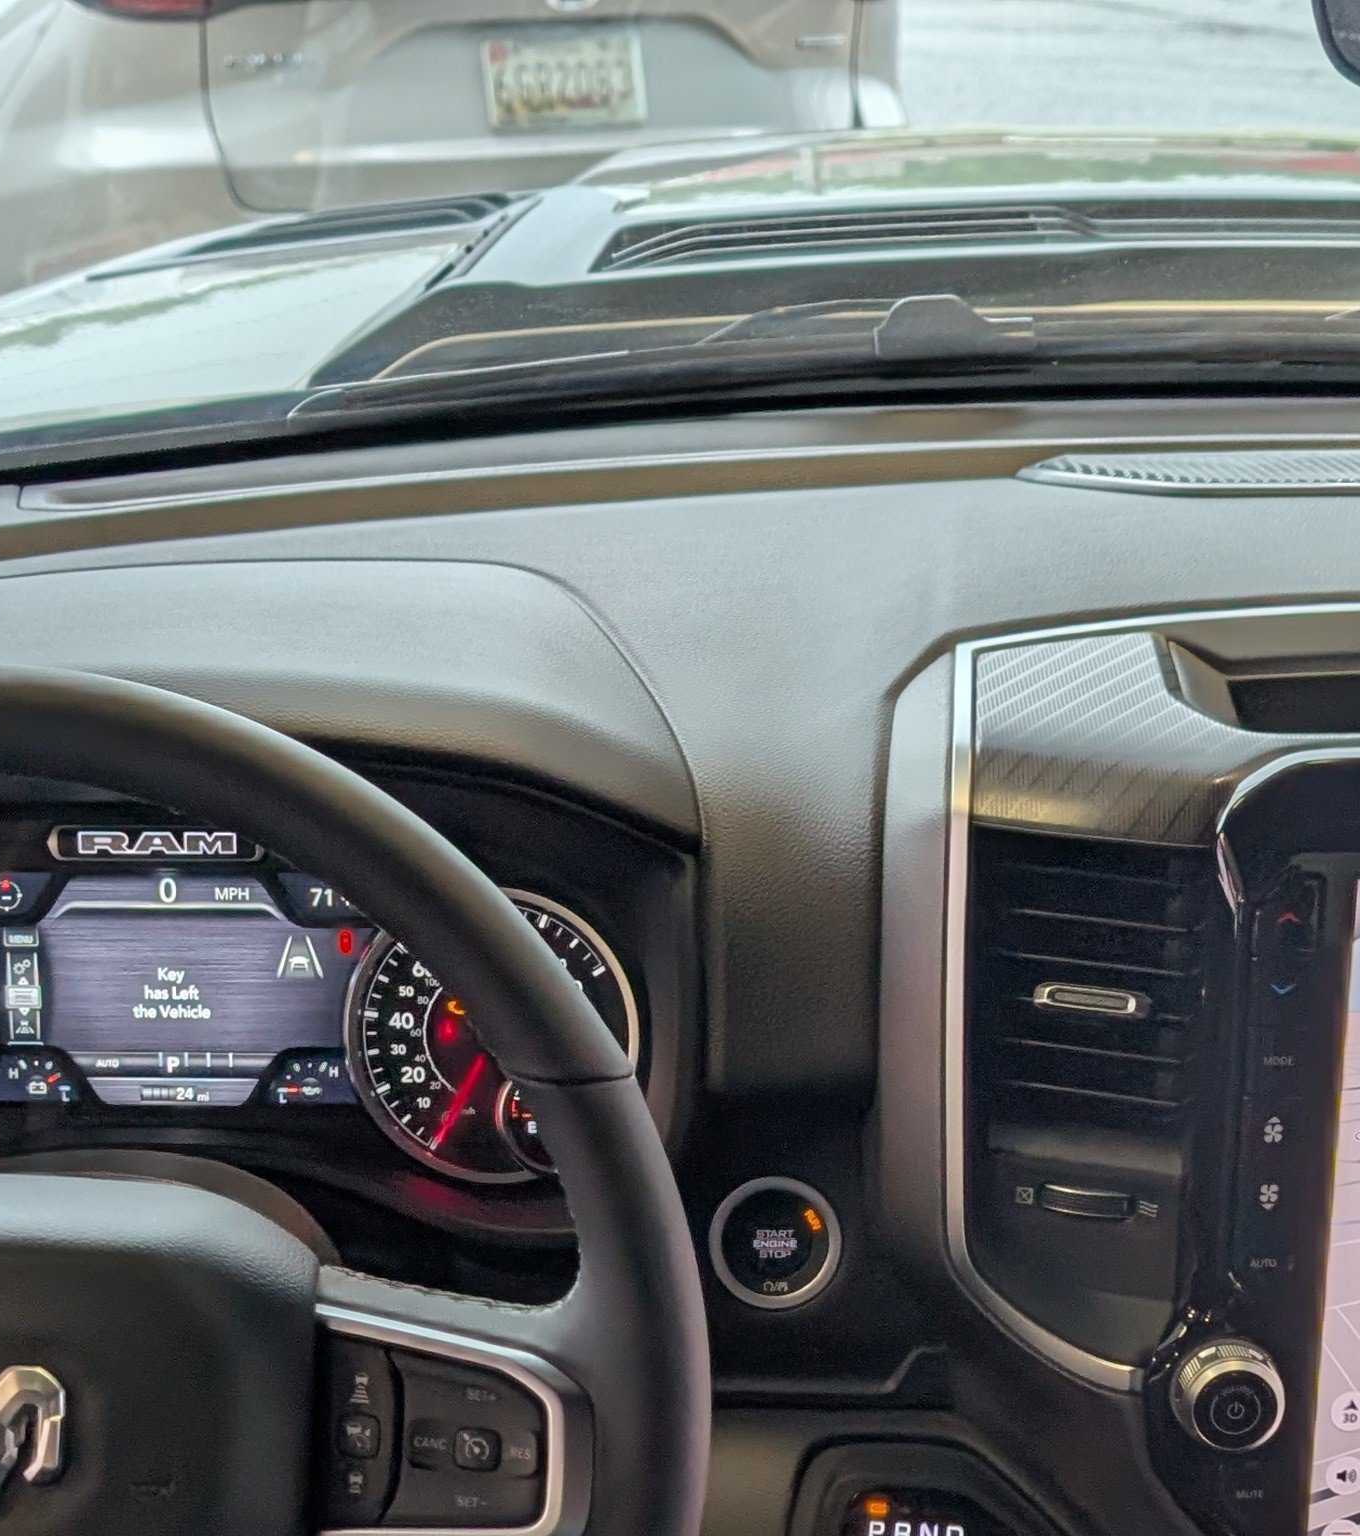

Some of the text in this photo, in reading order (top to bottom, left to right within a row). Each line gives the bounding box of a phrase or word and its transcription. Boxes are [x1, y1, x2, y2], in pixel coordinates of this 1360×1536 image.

[77, 831, 237, 855] RAM
[159, 877, 250, 903] 0 MPH
[157, 967, 185, 984] Key
[144, 985, 200, 1000] has Left
[398, 985, 415, 997] 50
[417, 995, 430, 1005] 80
[132, 1004, 212, 1019] the Vehicle
[389, 1011, 415, 1030] 40
[410, 1027, 422, 1038] 60
[390, 1043, 407, 1055] 30
[95, 1058, 120, 1068] AUTO
[414, 1053, 426, 1063] 40
[166, 1056, 180, 1073] P
[8, 1067, 19, 1080] H
[329, 1066, 339, 1078] H
[400, 1066, 426, 1083] 20
[429, 1080, 441, 1090] 20
[176, 1087, 210, 1101] 24 mi
[416, 1096, 432, 1109] 10
[527, 1120, 538, 1134] E
[755, 1229, 795, 1238] START
[753, 1239, 798, 1248] ENGINE
[759, 1250, 792, 1259] STOP
[1250, 1258, 1277, 1268] AUTO
[1342, 1413, 1359, 1424] 3D
